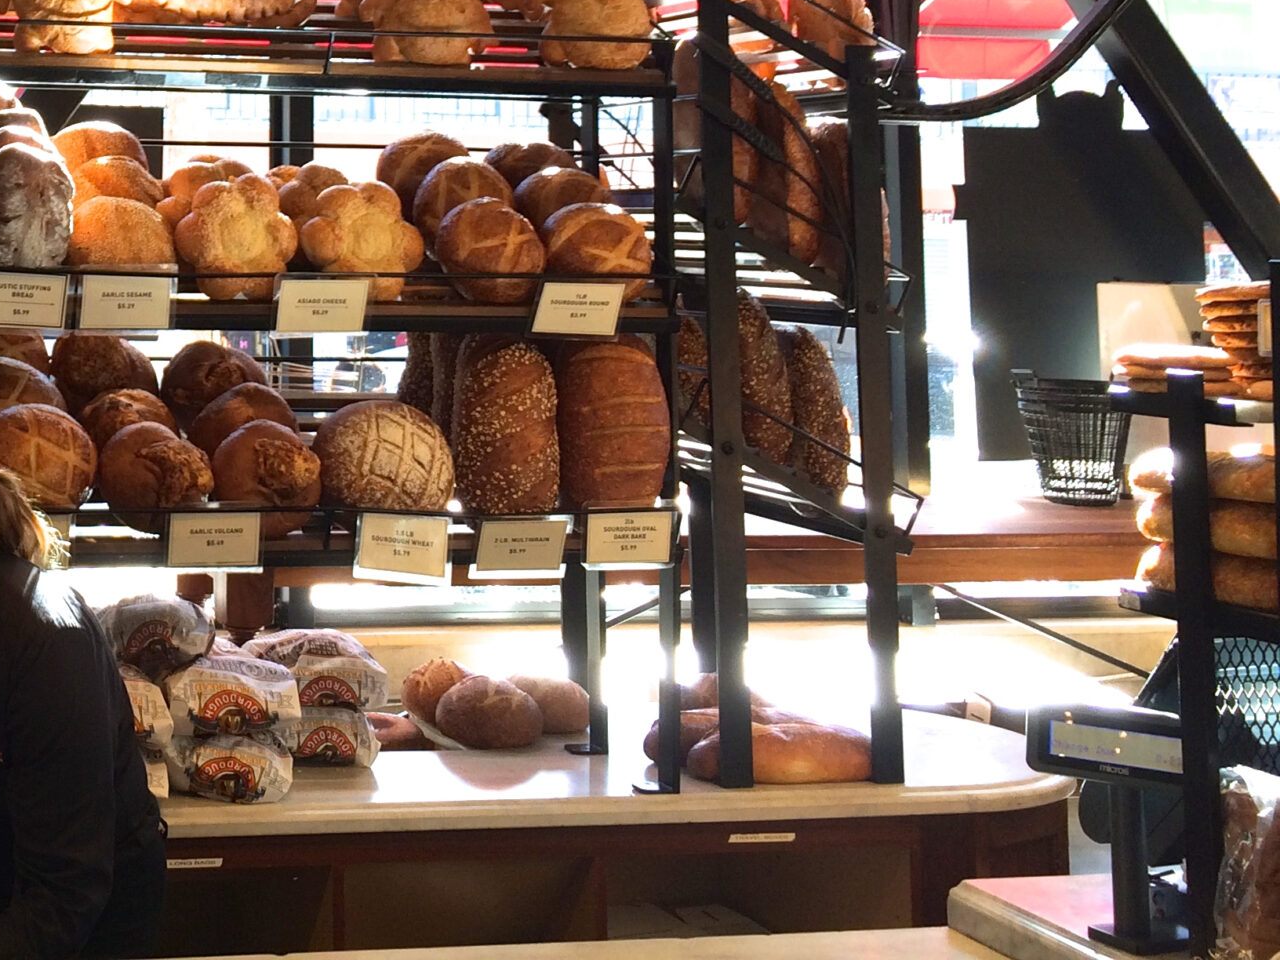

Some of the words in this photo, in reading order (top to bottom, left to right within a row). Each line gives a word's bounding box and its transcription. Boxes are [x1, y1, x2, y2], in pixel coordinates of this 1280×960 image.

[19, 284, 52, 292] STUFFING
[371, 535, 410, 544] SOURDOUGH
[412, 539, 434, 548] WHEAT
[130, 624, 170, 653] URDOUGH
[204, 693, 262, 720] SOURDOUGH
[1098, 764, 1130, 776] micros
